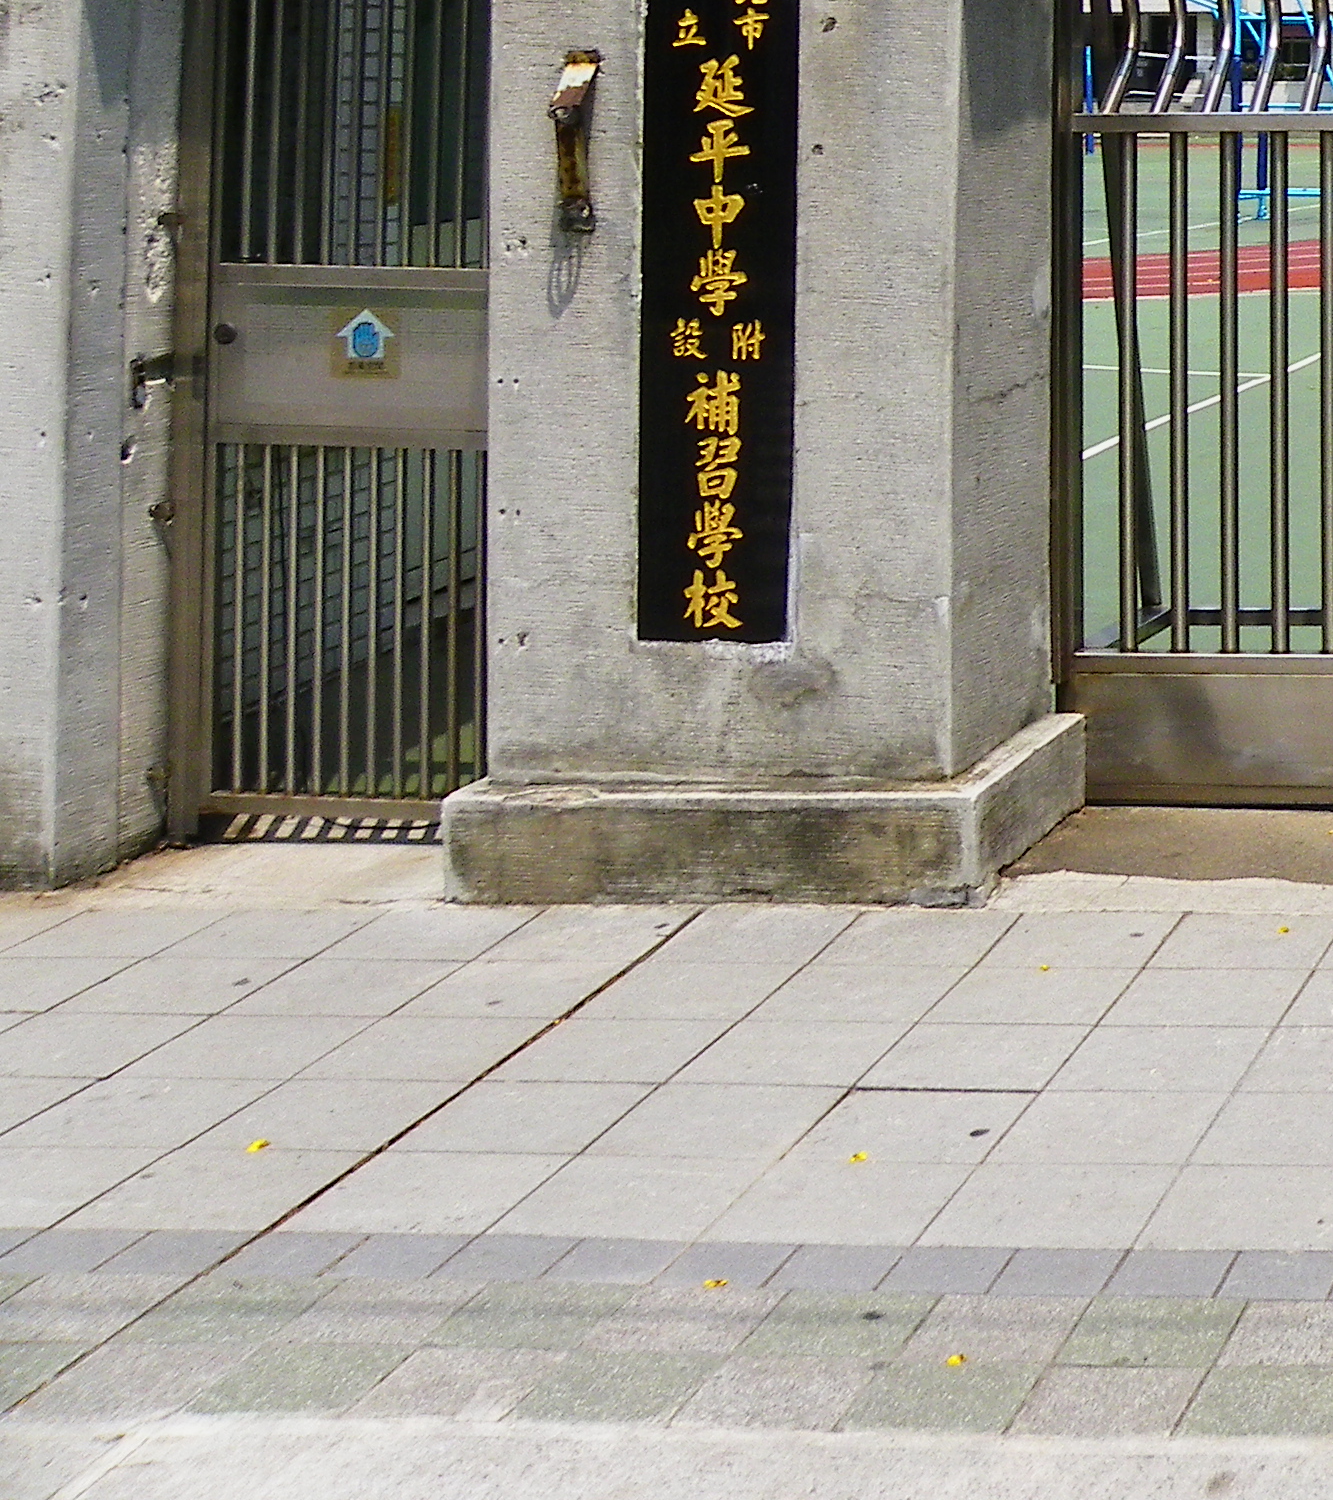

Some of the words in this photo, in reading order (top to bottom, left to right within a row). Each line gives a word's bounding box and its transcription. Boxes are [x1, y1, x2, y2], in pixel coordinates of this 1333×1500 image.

[688, 53, 756, 317] 延平中學
[683, 369, 744, 630] 補習學校
